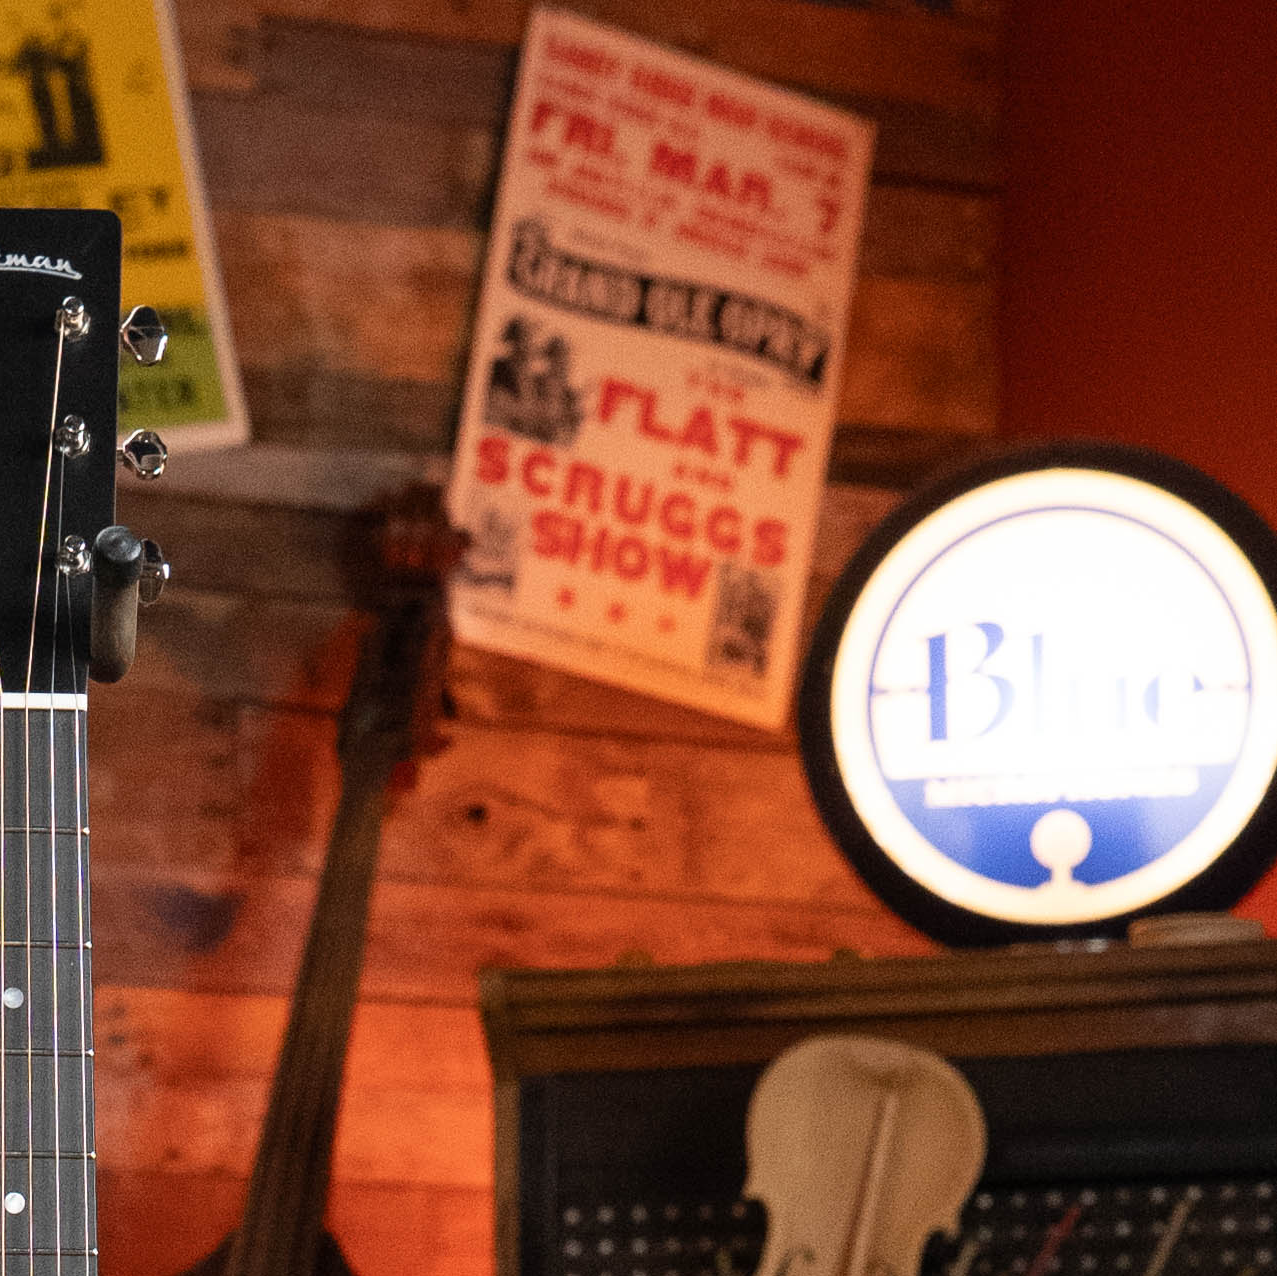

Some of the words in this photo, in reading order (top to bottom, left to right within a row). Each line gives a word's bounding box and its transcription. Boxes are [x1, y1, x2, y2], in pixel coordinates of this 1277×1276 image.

[597, 377, 804, 477] FLATT
[477, 434, 787, 567] SCRUGGS
[533, 511, 712, 600] SHOW
